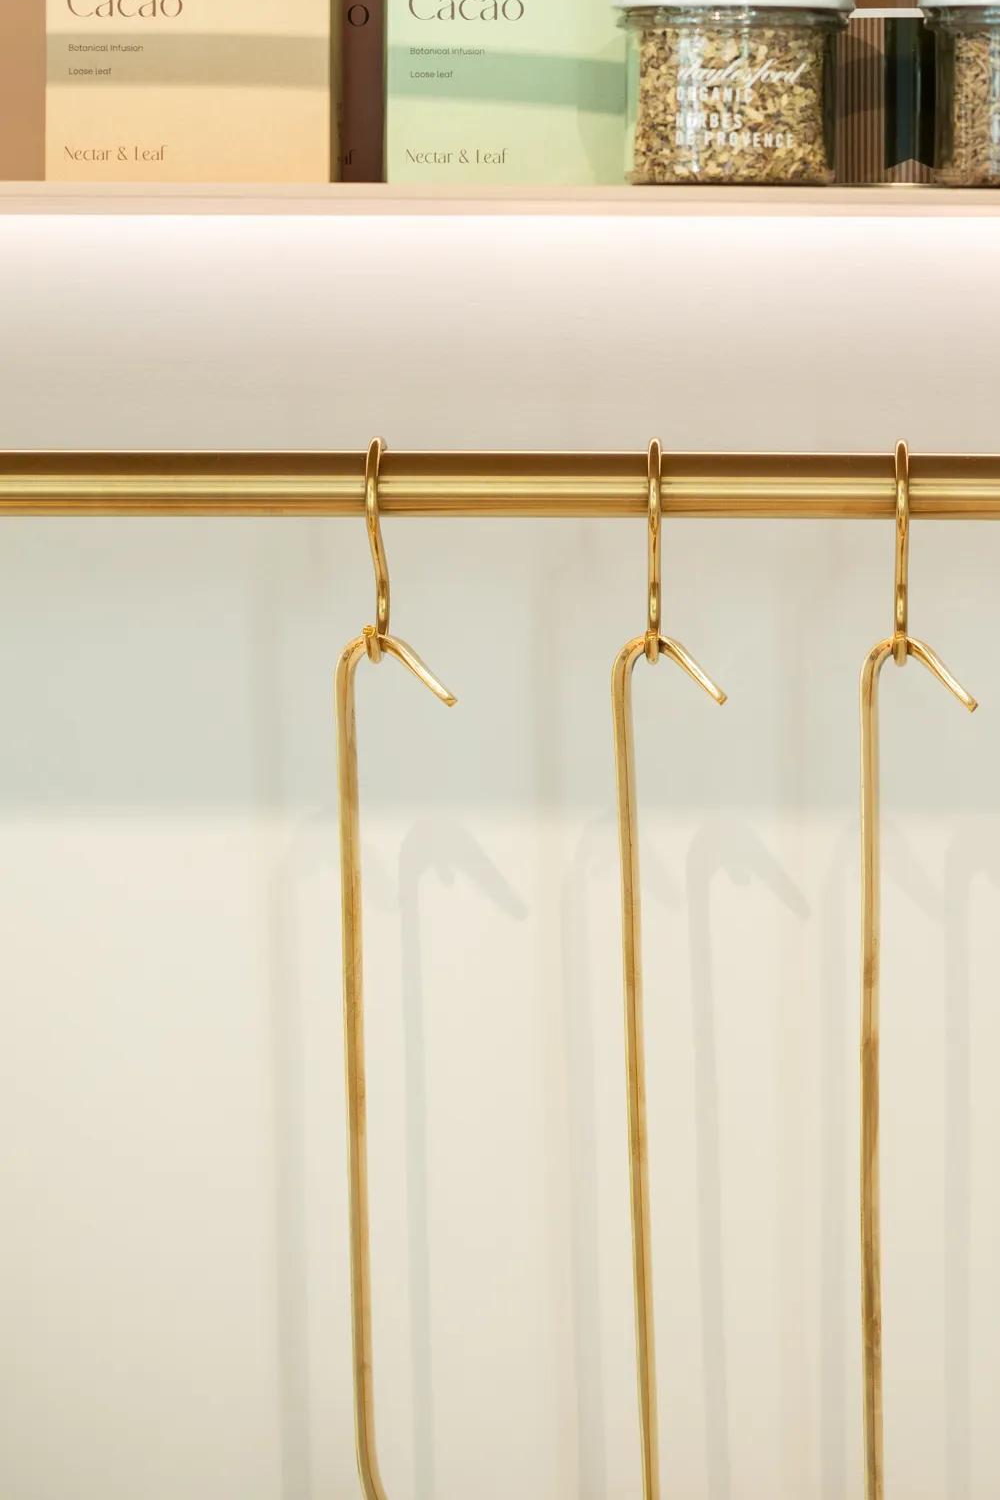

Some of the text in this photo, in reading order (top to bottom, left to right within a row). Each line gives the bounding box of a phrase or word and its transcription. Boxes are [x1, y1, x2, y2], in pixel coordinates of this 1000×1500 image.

[68, 43, 144, 52] Botanical Infusion
[409, 47, 450, 56] Botanical
[68, 67, 94, 76] Loose
[410, 70, 435, 79] Loose
[704, 131, 794, 148] PROVENCE
[64, 144, 168, 161] Nectar & Leaf
[405, 147, 509, 164] Nectar & Leaf
